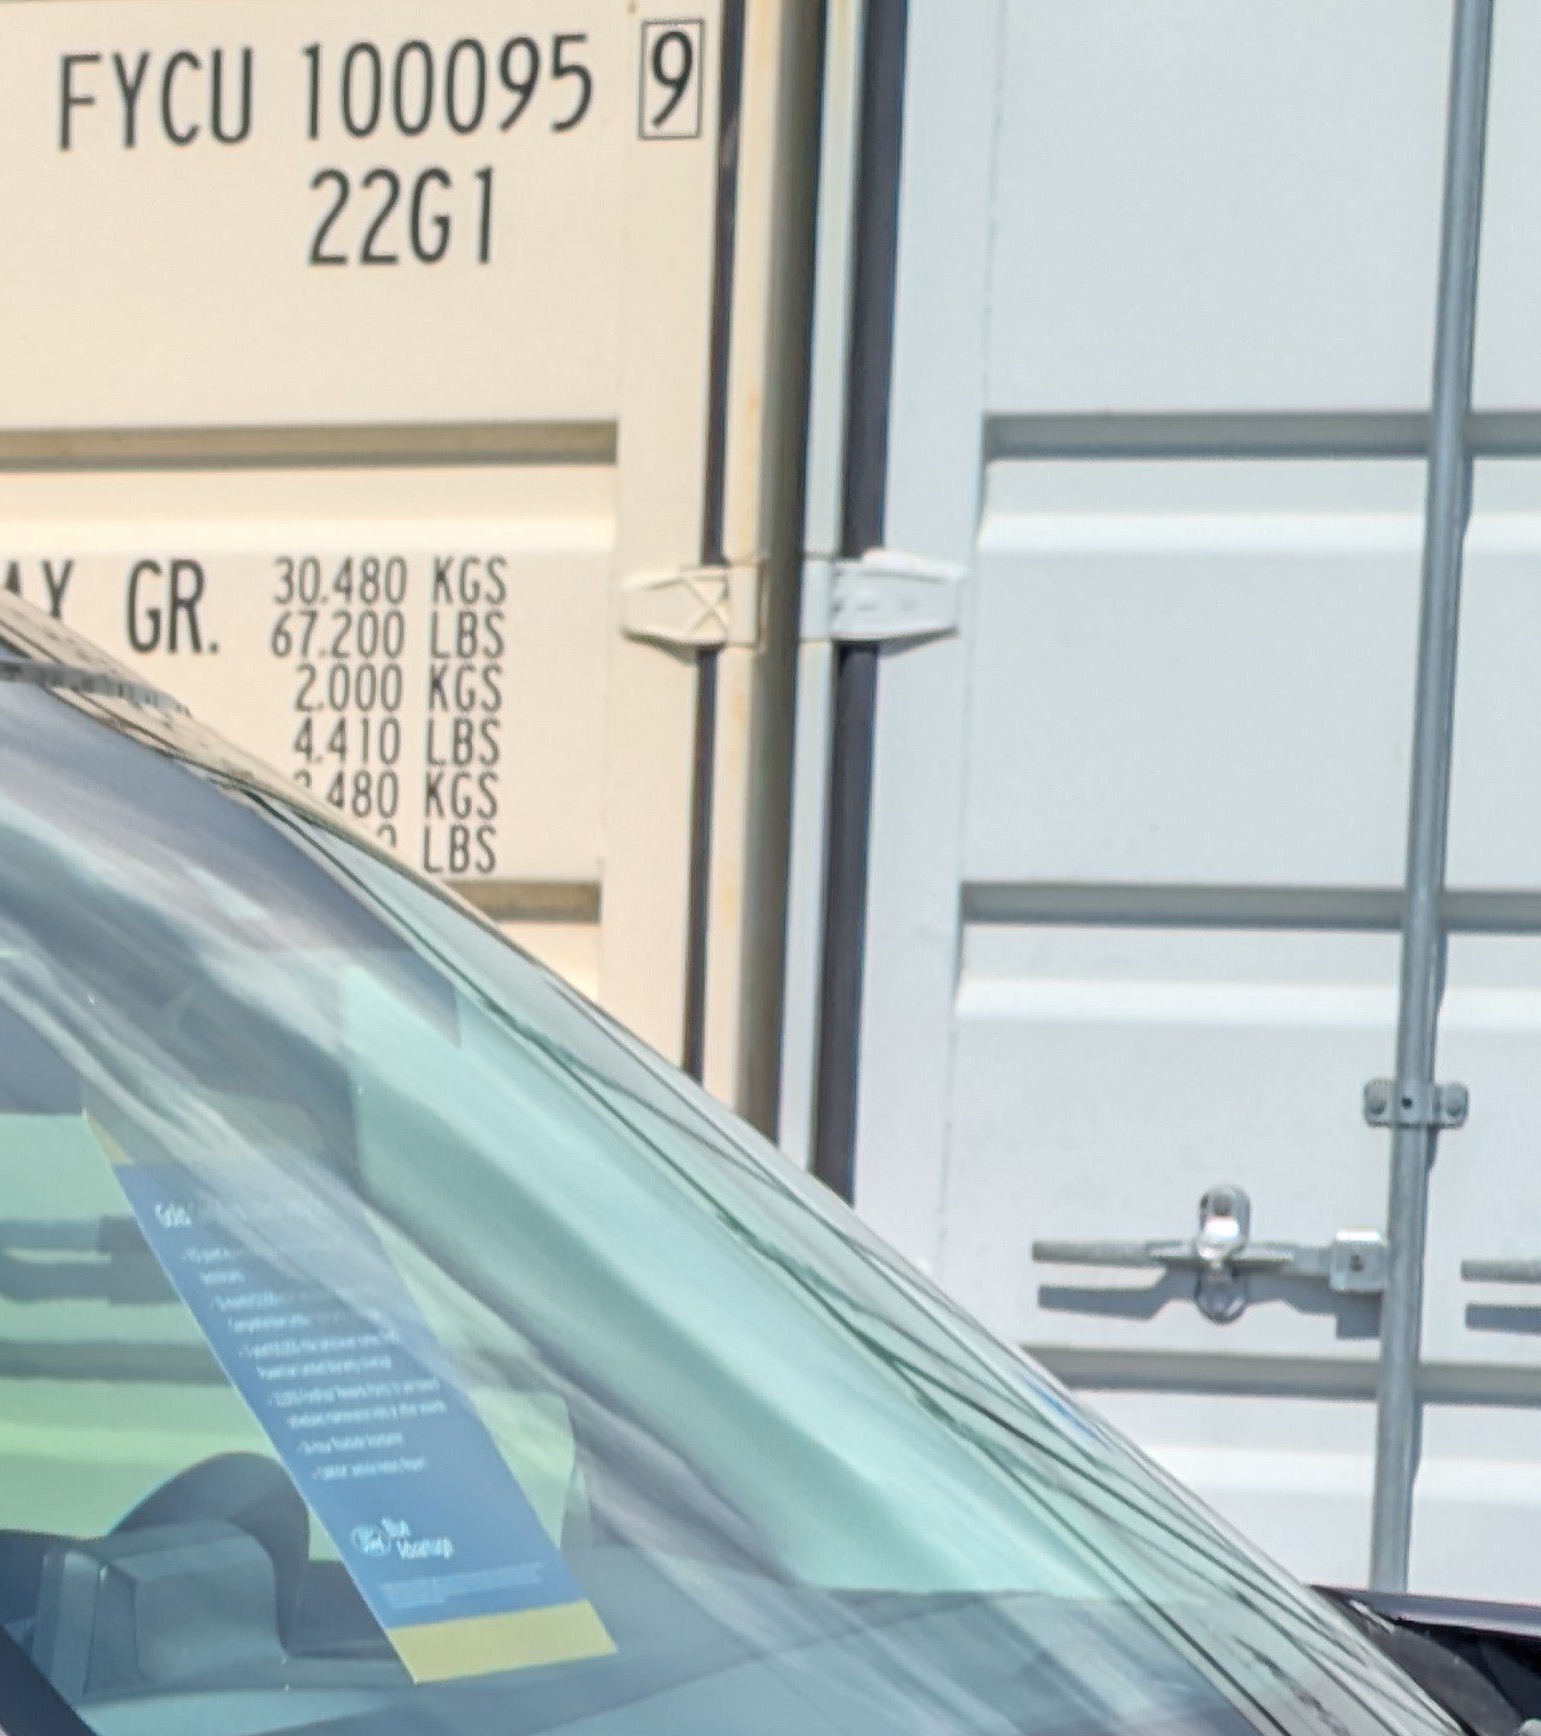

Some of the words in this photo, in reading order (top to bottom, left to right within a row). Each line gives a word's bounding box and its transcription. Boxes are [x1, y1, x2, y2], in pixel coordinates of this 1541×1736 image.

[60, 46, 252, 151] FYCU
[302, 33, 593, 141] 100095
[651, 31, 693, 129] 9
[308, 165, 494, 266] 22G1
[273, 556, 407, 604] 30.480
[433, 556, 508, 604] KGS
[126, 559, 219, 655] GR.
[271, 610, 405, 659] 67.200
[431, 610, 505, 659] LBS
[294, 663, 403, 712] 2.000
[428, 663, 503, 713] KGS
[294, 717, 400, 765] 4.410
[426, 717, 501, 766] LBS
[424, 770, 499, 819] KGS
[423, 824, 497, 874] LBS
